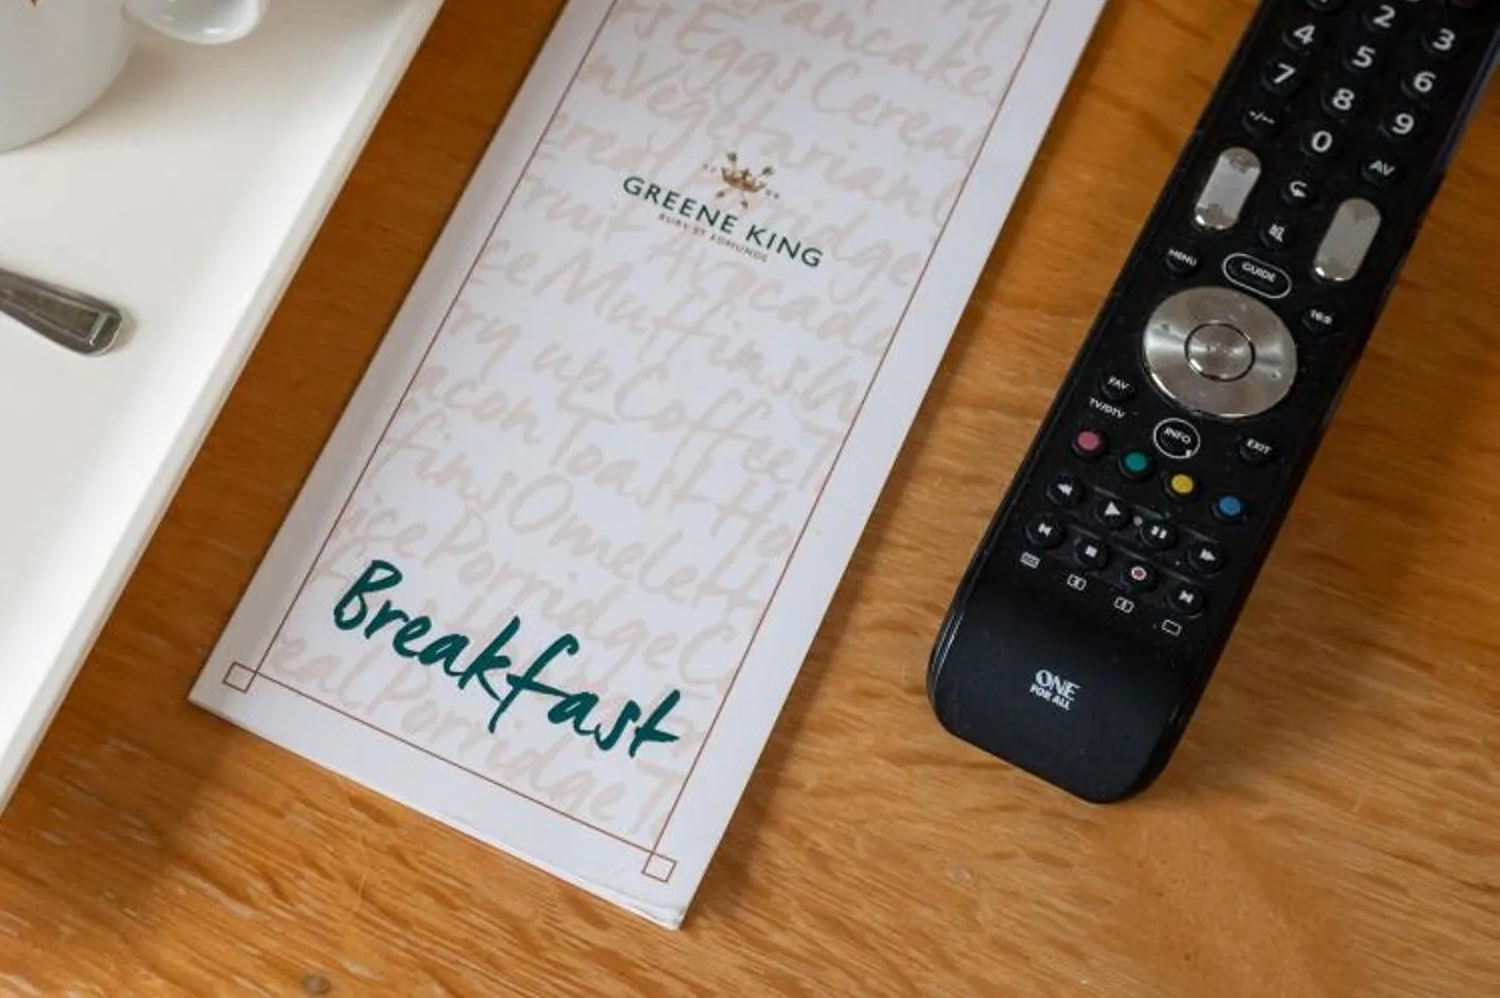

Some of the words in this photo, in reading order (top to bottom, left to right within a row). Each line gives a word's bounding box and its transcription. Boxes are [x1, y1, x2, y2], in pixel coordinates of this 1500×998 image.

[1374, 5, 1395, 28] 2
[1293, 24, 1315, 45] 4
[1433, 29, 1455, 51] 3
[1353, 47, 1375, 69] 5
[1275, 64, 1297, 85] 7
[1413, 71, 1436, 93] 6
[1332, 89, 1355, 111] 8
[1393, 113, 1415, 136] 9
[1311, 131, 1333, 152] 0
[1369, 160, 1395, 177] AV
[622, 175, 739, 235] GREENE
[745, 223, 824, 268] KING
[1168, 249, 1198, 267] MENU
[1241, 261, 1277, 283] GUIDE
[1107, 375, 1130, 391] FAV
[1163, 427, 1192, 445] INFO
[1246, 438, 1273, 454] EXIT
[333, 559, 680, 757] Breakfast
[1035, 669, 1081, 701] ONE
[1029, 683, 1052, 702] FOR
[1052, 695, 1071, 711] ALL
